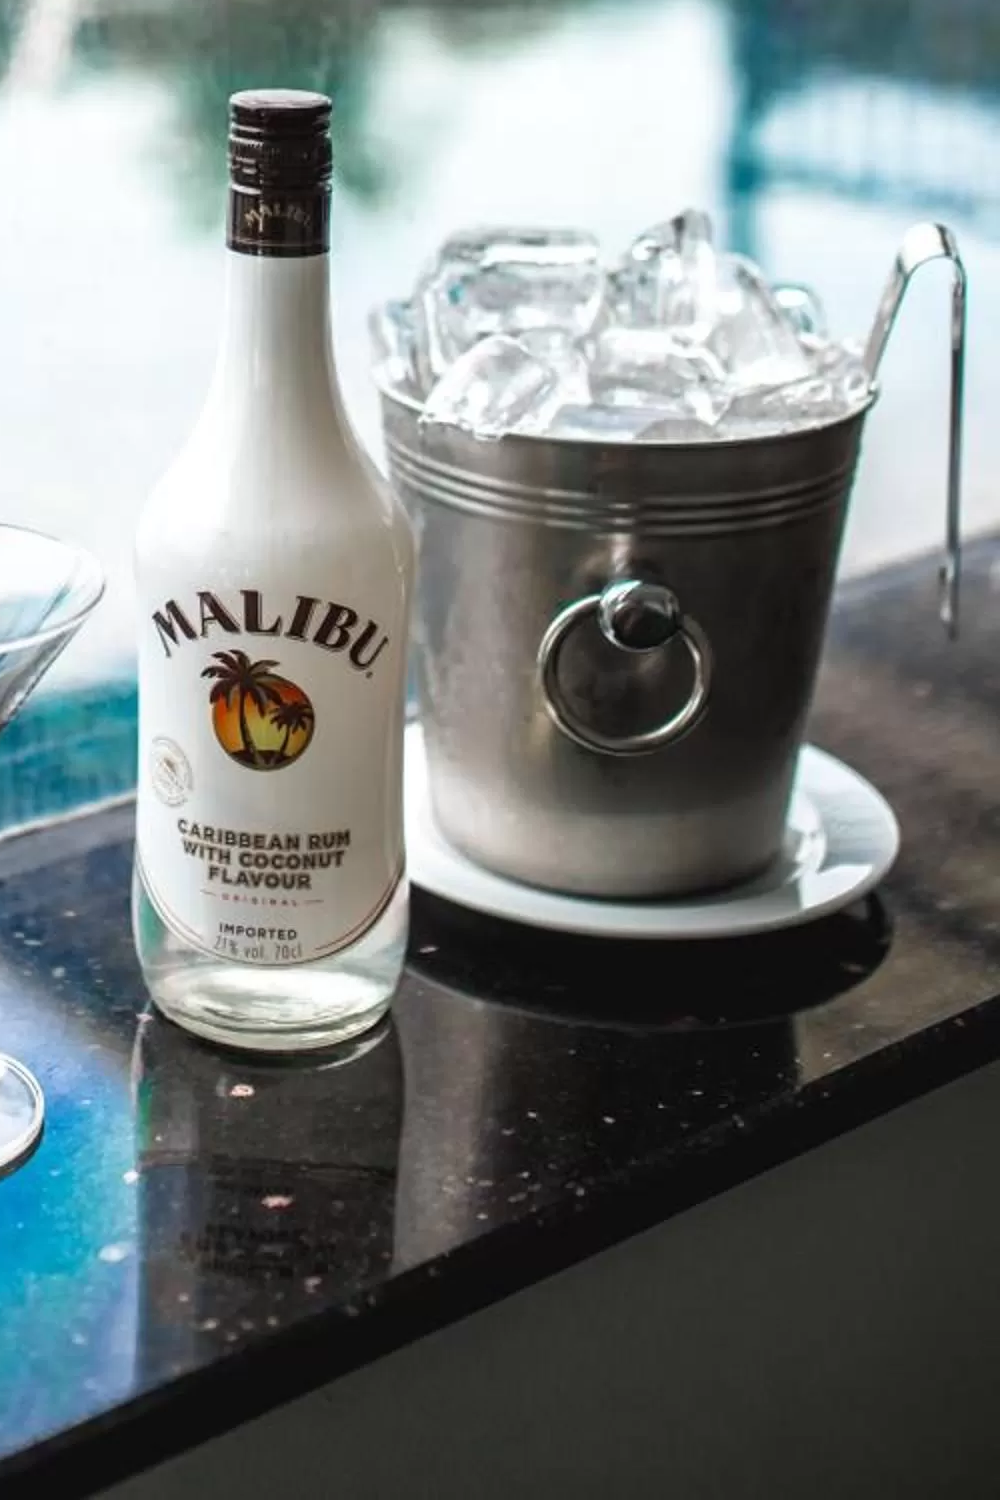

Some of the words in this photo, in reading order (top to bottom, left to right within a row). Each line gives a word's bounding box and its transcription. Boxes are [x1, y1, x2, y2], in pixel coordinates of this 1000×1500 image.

[151, 589, 389, 671] MALIBU
[177, 819, 300, 850] CARIBBEAN
[308, 829, 351, 849] RUM
[182, 839, 231, 866] WITH
[239, 850, 345, 870] COCONUT
[207, 866, 312, 890] FLAVOUR
[218, 922, 298, 941] IMPORTED
[274, 943, 302, 961] 70cl
